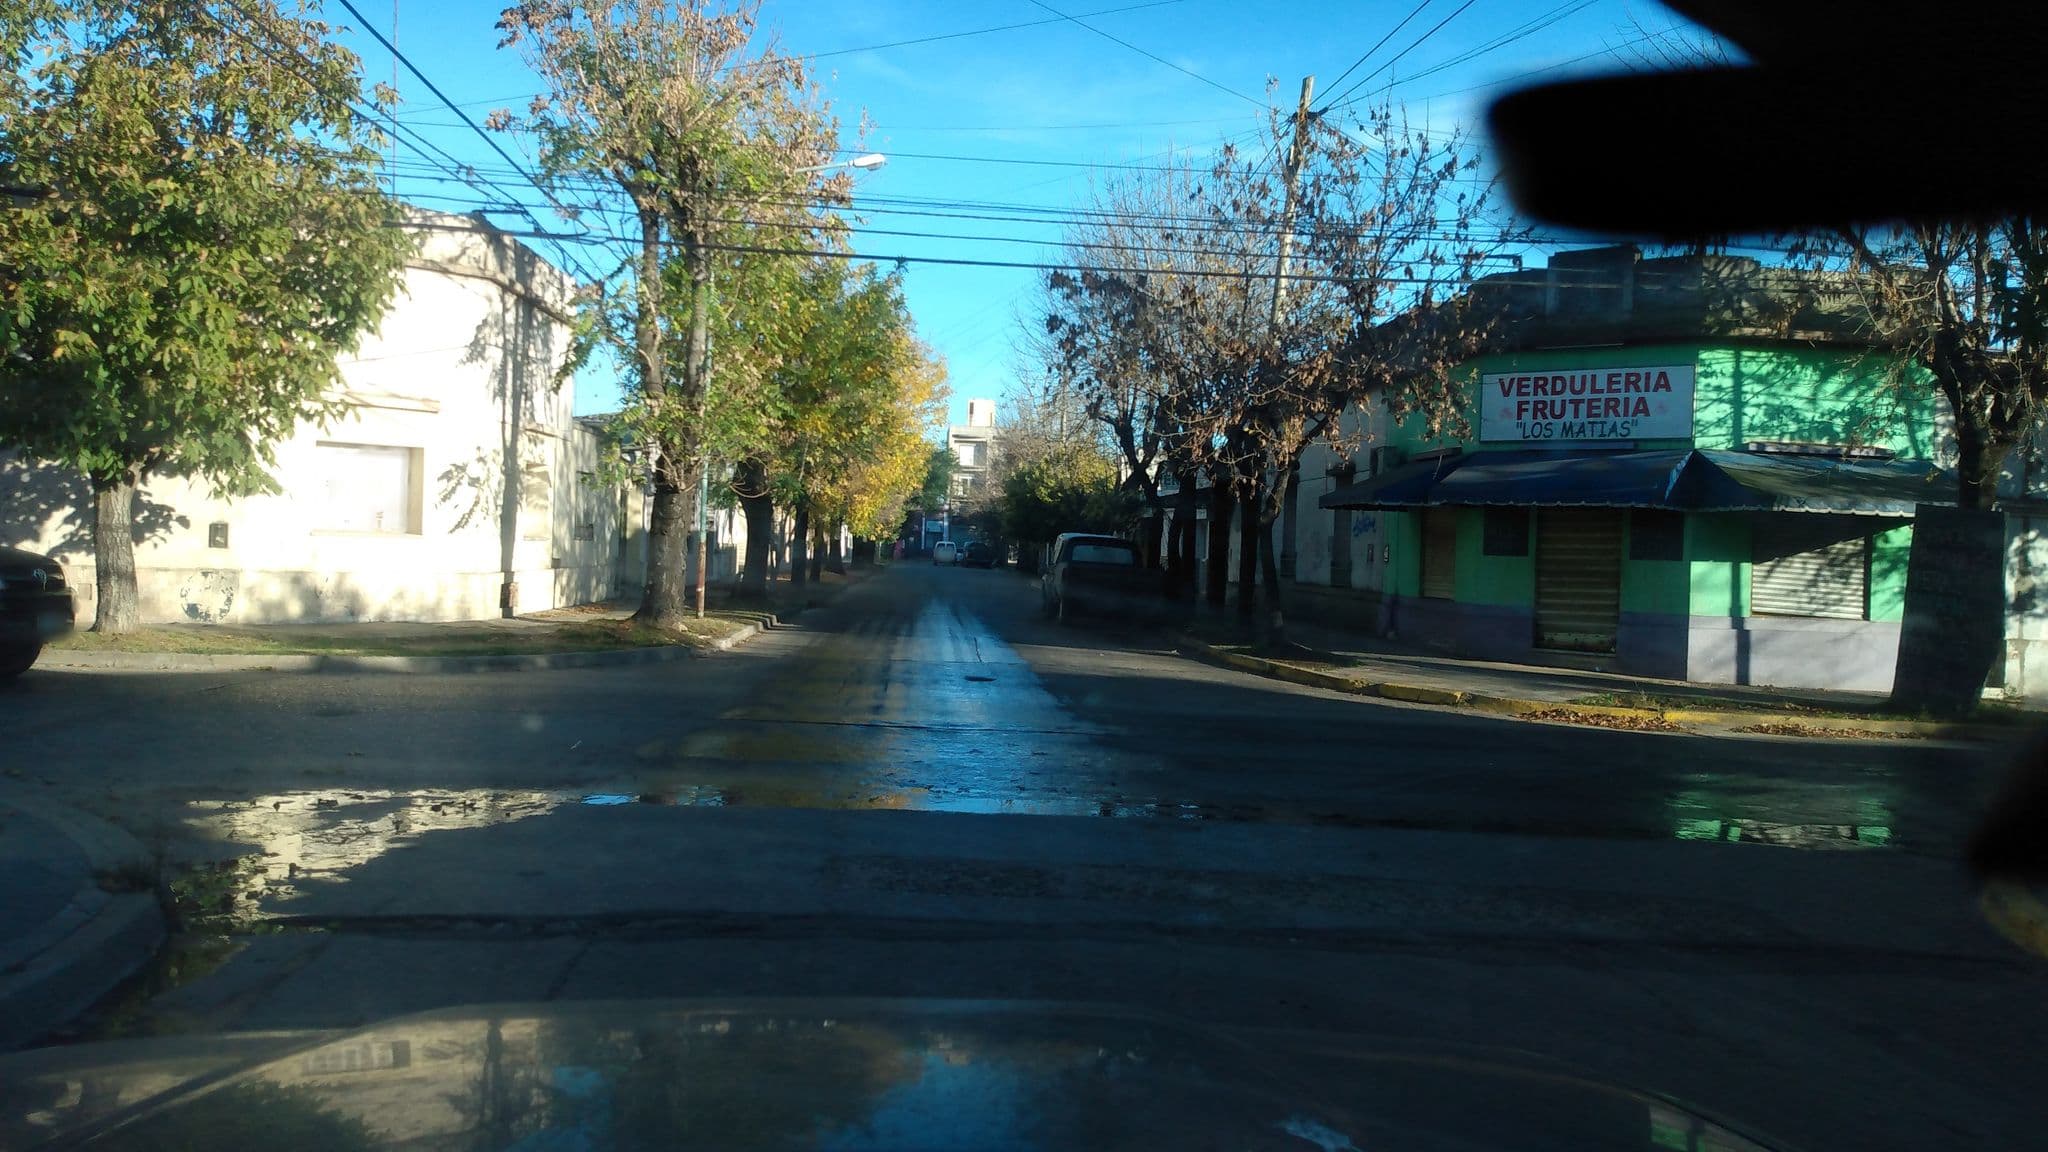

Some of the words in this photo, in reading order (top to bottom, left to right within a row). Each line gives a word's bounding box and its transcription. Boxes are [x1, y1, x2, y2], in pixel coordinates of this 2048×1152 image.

[1498, 371, 1672, 398] VERDULERIA
[1516, 396, 1651, 420] FRUTERIA
[1516, 421, 1553, 439] "LOS
[1561, 419, 1638, 438] MATIAS"
